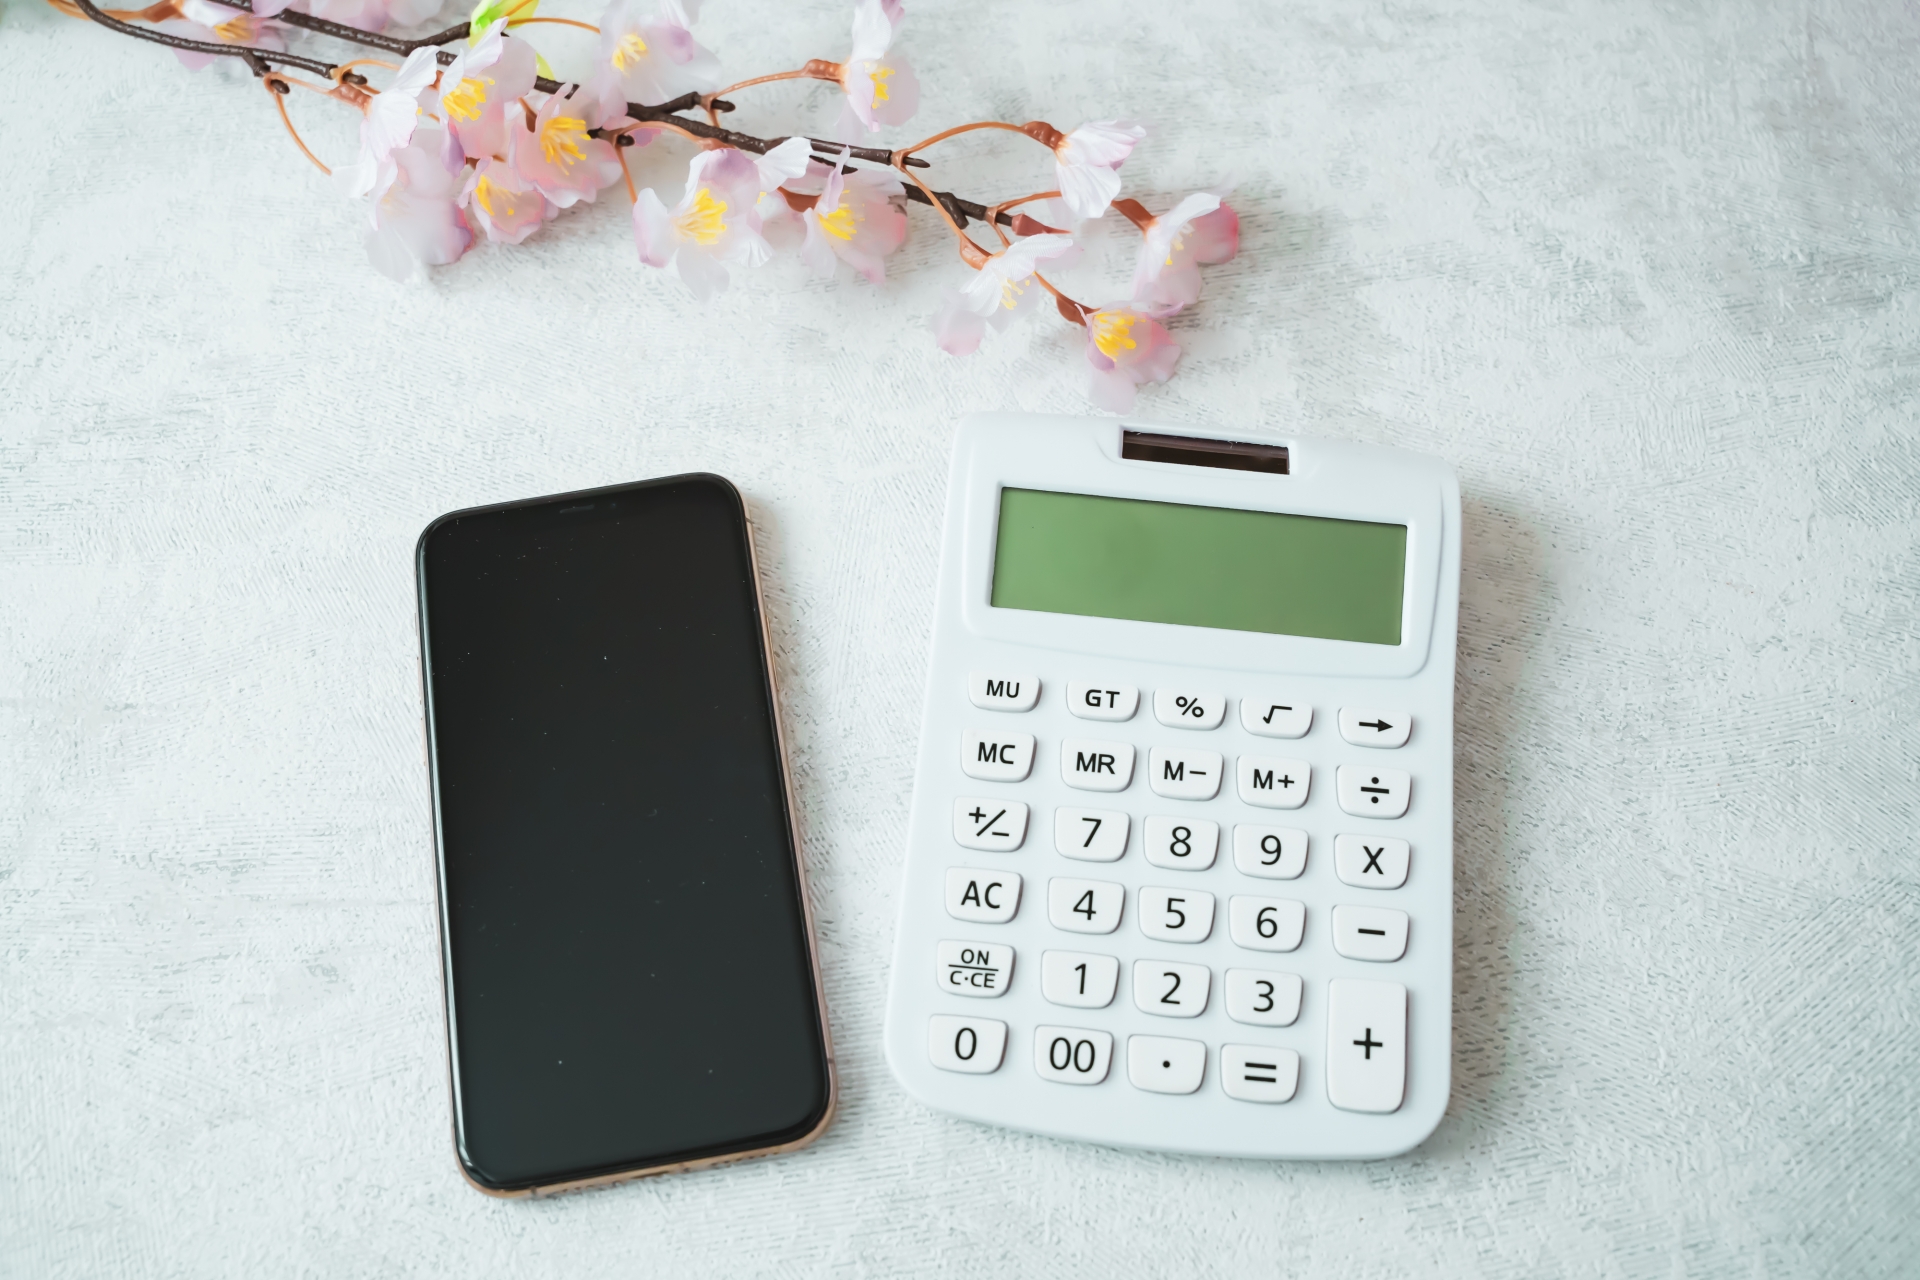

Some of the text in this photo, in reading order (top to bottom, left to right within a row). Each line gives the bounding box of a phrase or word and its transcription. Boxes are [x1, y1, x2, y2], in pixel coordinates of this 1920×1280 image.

[986, 680, 1019, 698] MU
[1085, 689, 1120, 709] GT
[1175, 696, 1205, 718] %
[977, 742, 1016, 765] MC
[1076, 752, 1116, 775] MR
[1253, 769, 1295, 790] M+
[1081, 817, 1102, 848] 7
[1169, 826, 1192, 858] 8
[1260, 834, 1282, 866] 9
[960, 880, 1003, 910] AC
[1072, 889, 1097, 921] 4
[1165, 897, 1186, 929] 5
[1256, 906, 1278, 939] 6
[960, 948, 990, 966] ON
[1074, 963, 1087, 995] 1
[1160, 971, 1181, 1005] 2
[1253, 980, 1275, 1013] 3
[954, 1027, 978, 1061] 0
[1049, 1036, 1096, 1073] 00
[1352, 1027, 1384, 1060] +
[1244, 1061, 1277, 1084] =
